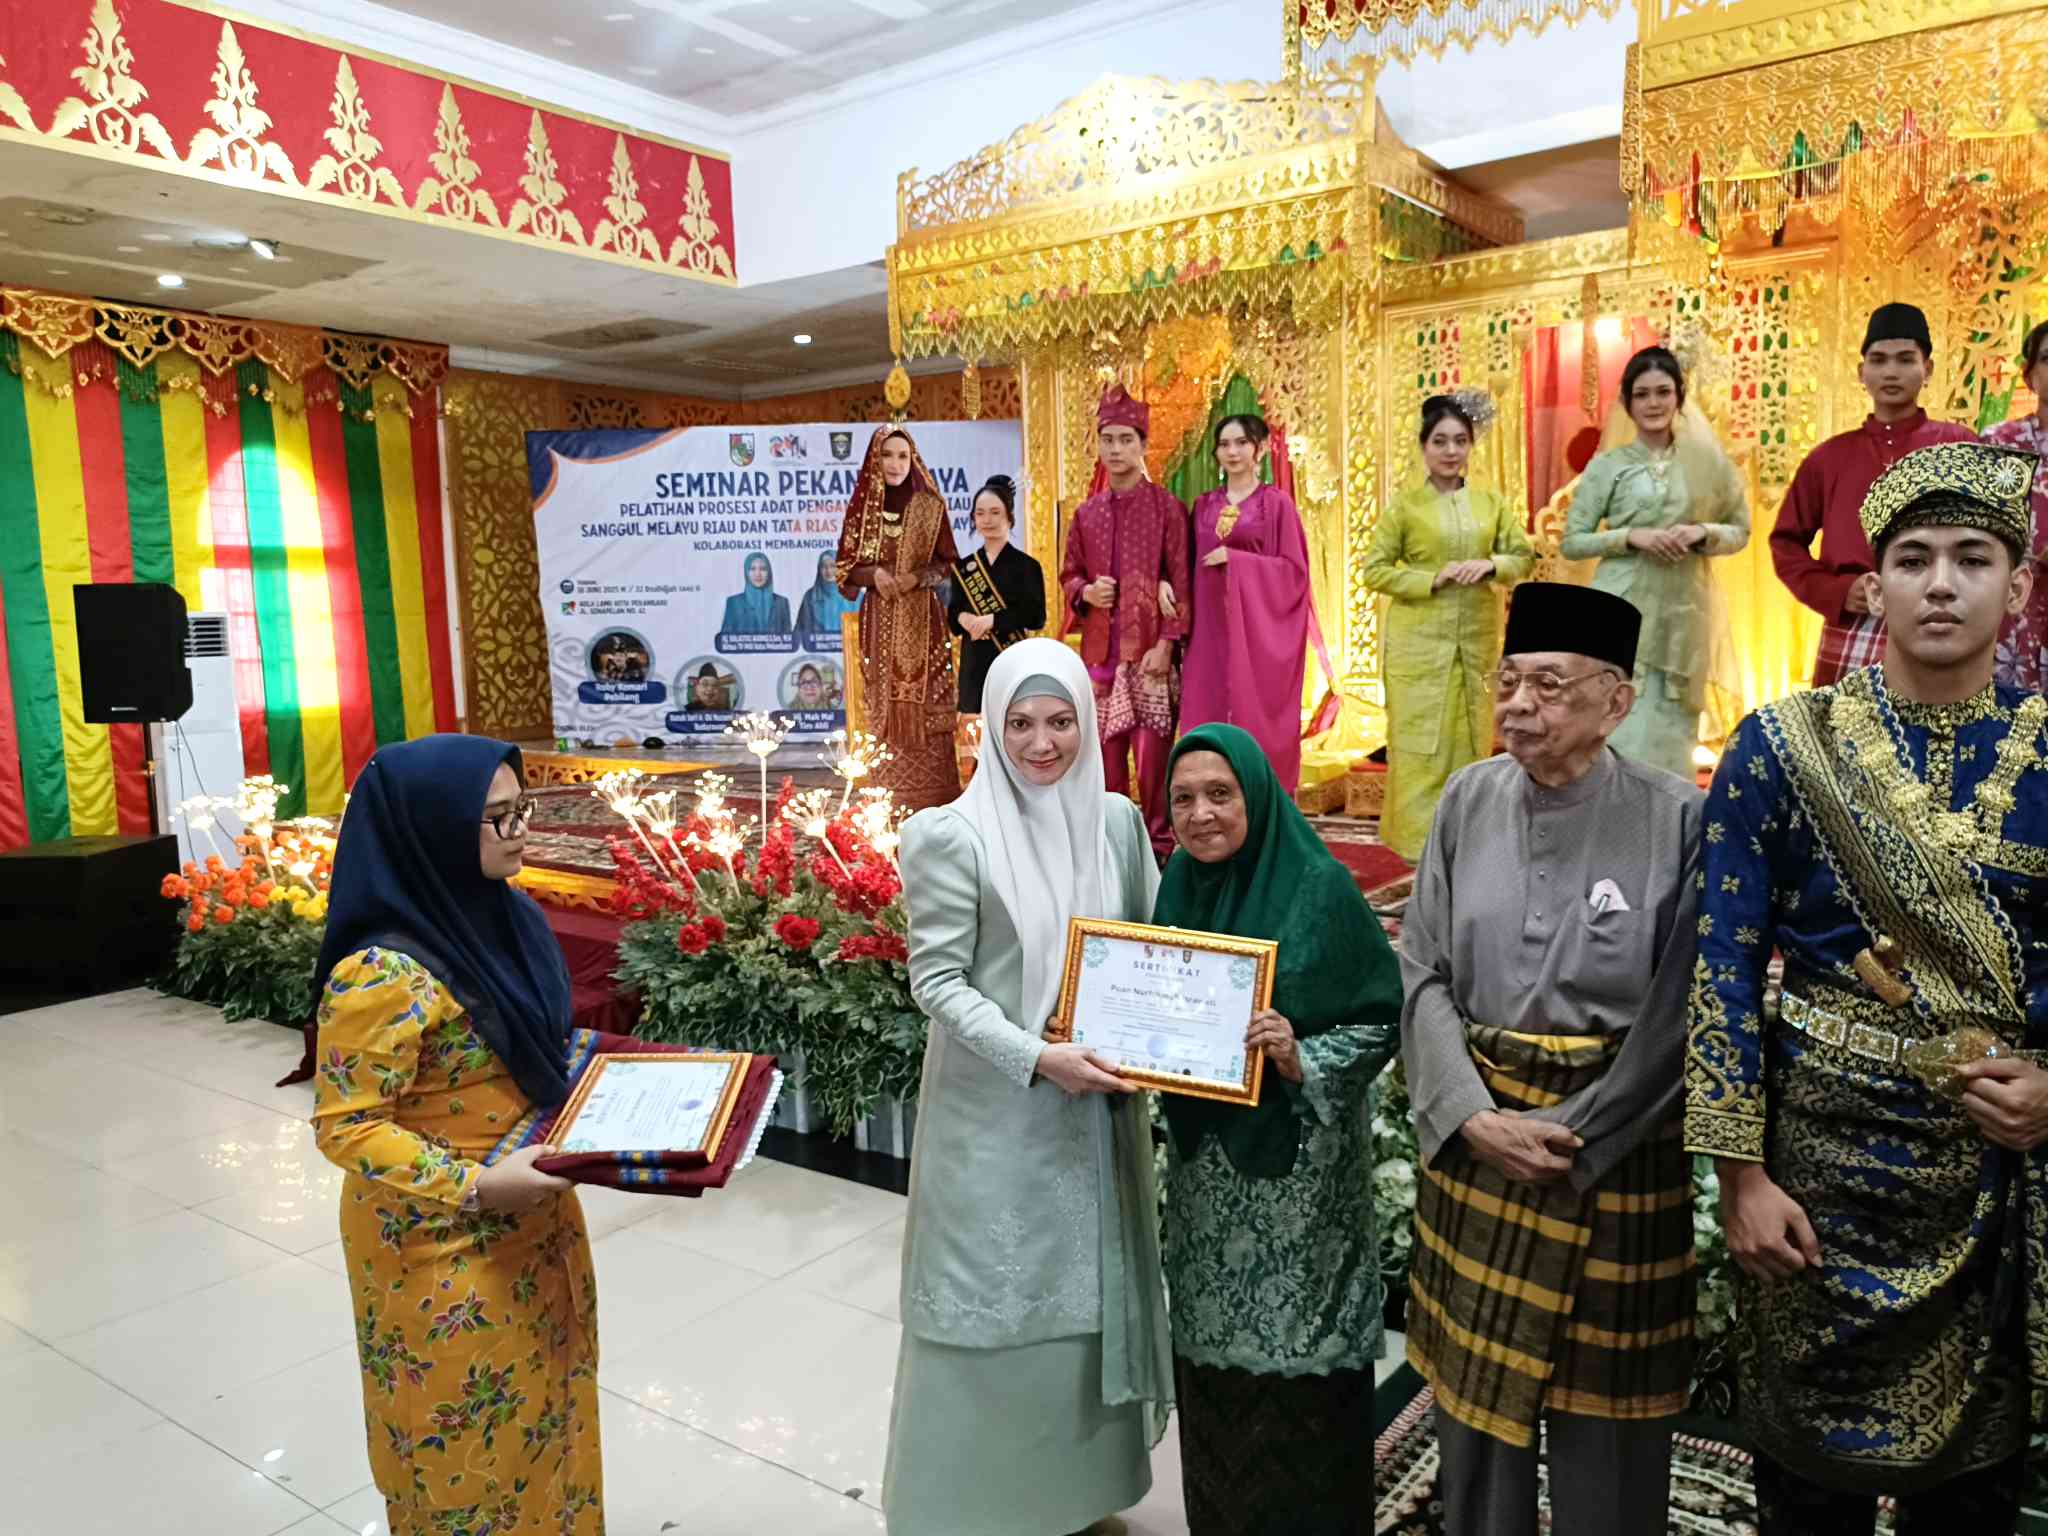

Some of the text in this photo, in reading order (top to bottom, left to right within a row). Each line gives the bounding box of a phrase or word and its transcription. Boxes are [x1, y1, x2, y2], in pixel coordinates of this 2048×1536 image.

[655, 467, 969, 498] SEMINAR PEKAN YA
[619, 502, 695, 517] PELATIHAN
[698, 500, 757, 515] PROSESI
[760, 500, 794, 514] ADAT
[947, 497, 971, 511] IAU
[580, 522, 644, 537] SANGGUL
[647, 520, 699, 535] MELAYU
[703, 519, 737, 534] RIAU
[740, 519, 768, 534] DAN
[771, 519, 802, 533] TATA
[806, 518, 838, 532] RIAS
[693, 539, 834, 551] KOLABORASI MEMBANGUN
[972, 571, 988, 592] MISS
[1133, 960, 1200, 976] SERTKAT
